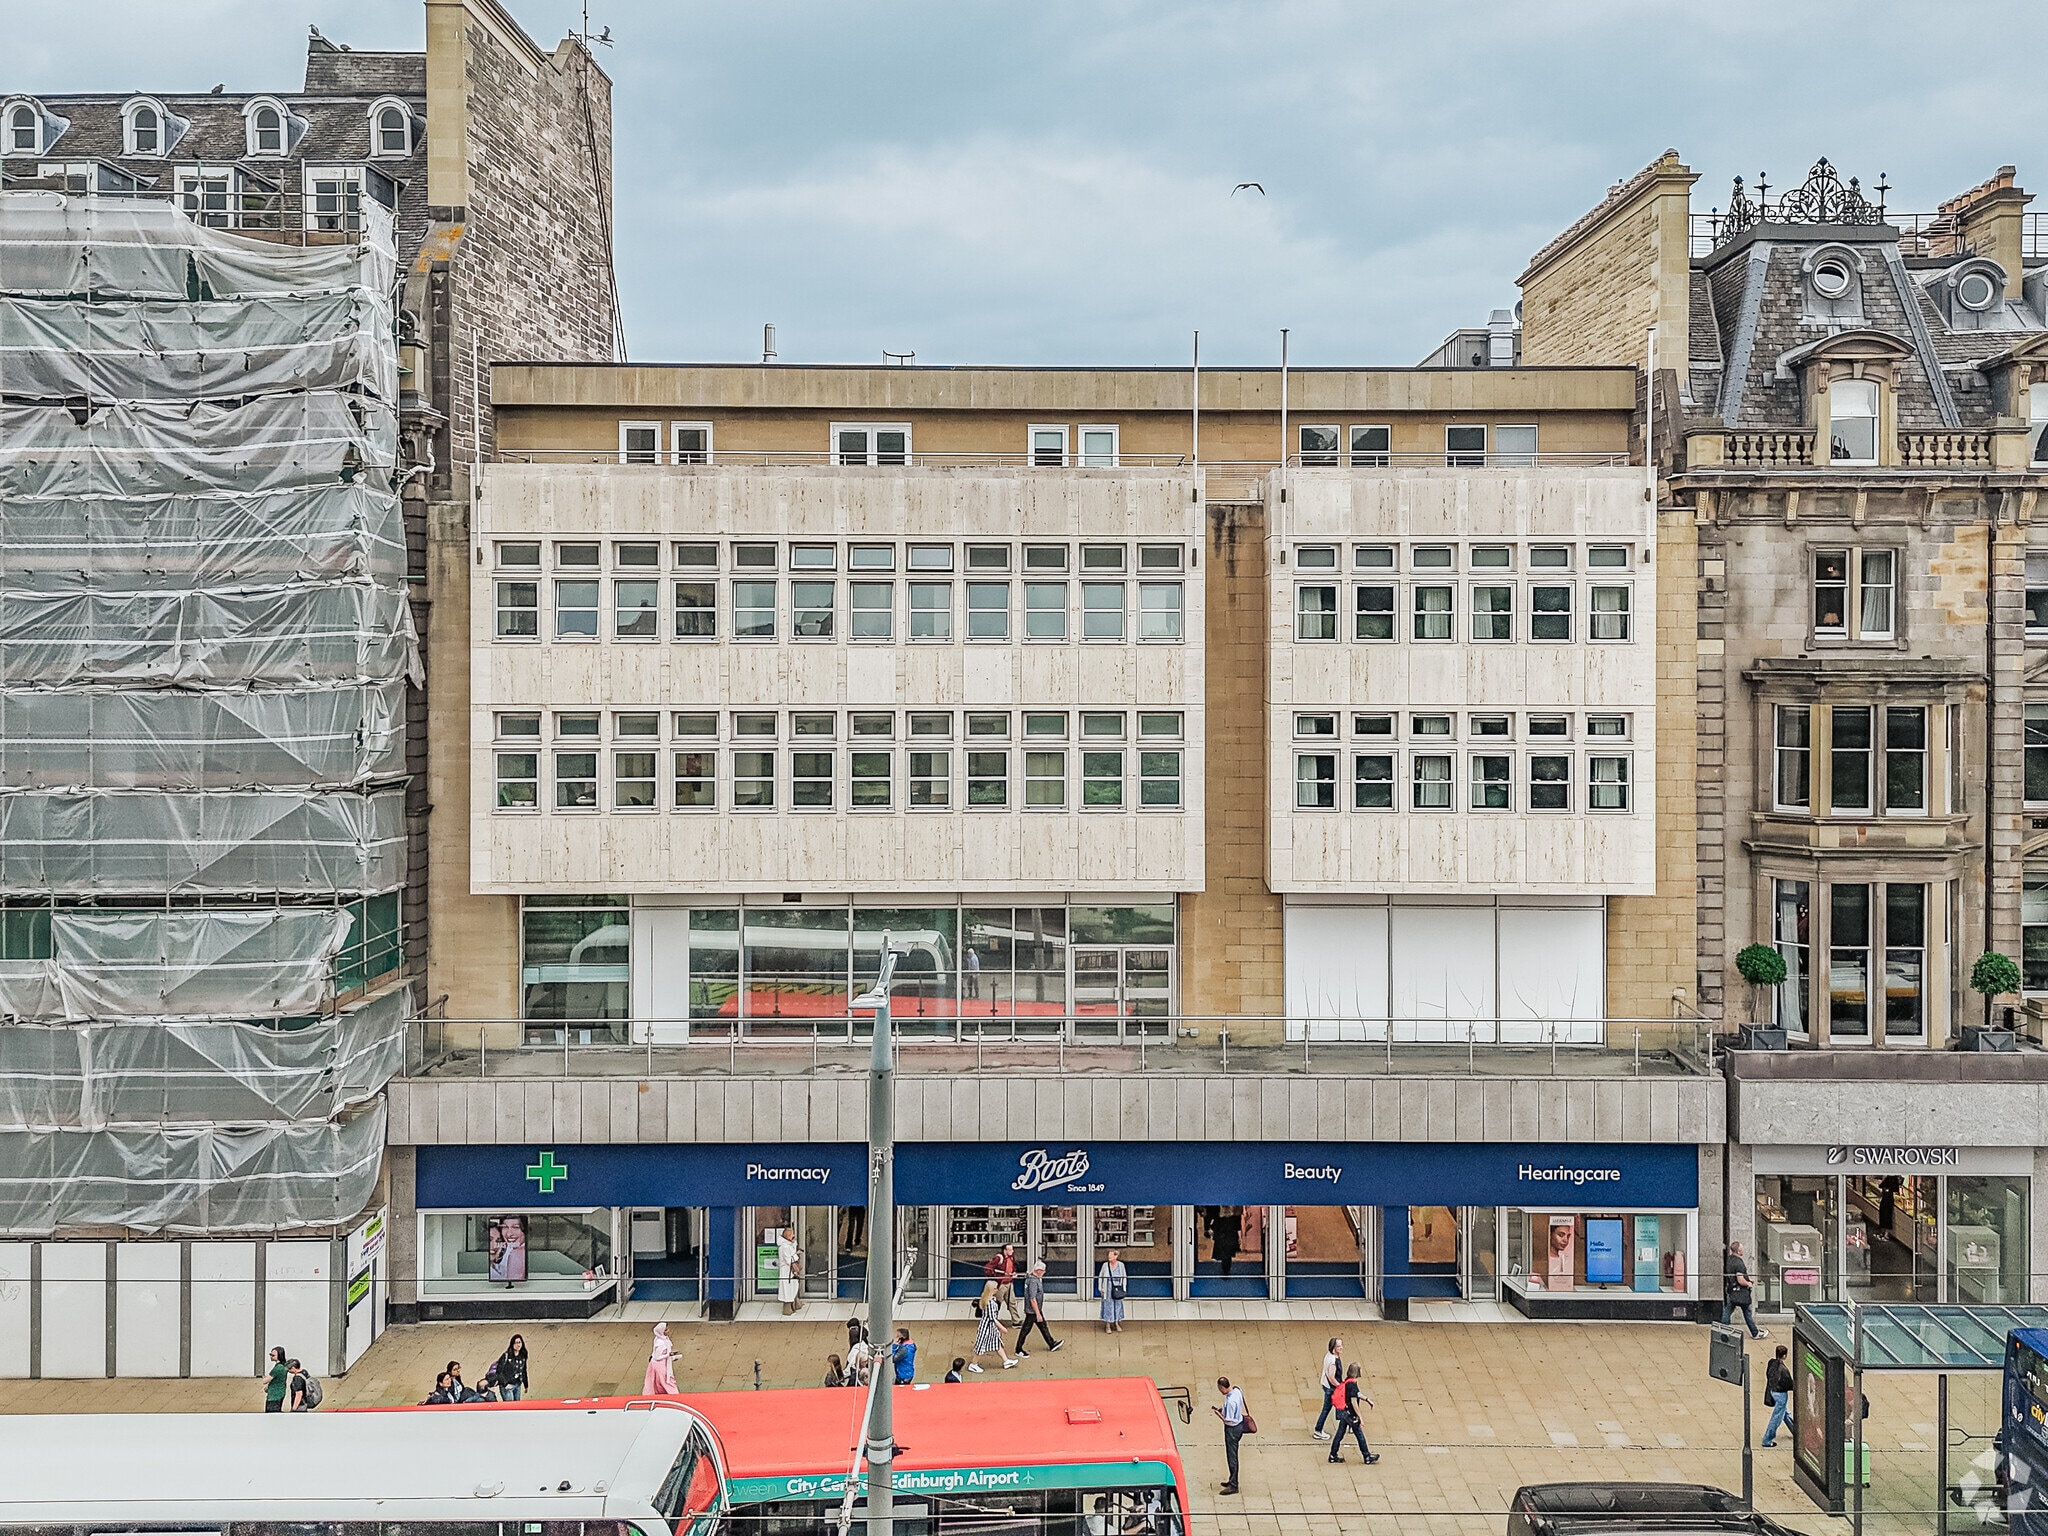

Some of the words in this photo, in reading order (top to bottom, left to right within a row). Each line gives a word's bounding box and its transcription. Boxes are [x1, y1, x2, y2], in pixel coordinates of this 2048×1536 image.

[1853, 1147, 1960, 1165] SWAROVSKI
[746, 1163, 831, 1184] Pharmacy
[1011, 1149, 1090, 1192] Boots
[1284, 1163, 1342, 1184] Beauty
[1518, 1164, 1621, 1186] Hearingcare
[1067, 1183, 1087, 1192] Since
[1088, 1183, 1105, 1192] 1849
[1791, 1273, 1812, 1281] SALE
[786, 1477, 817, 1497] City
[820, 1476, 869, 1493] Cenre
[892, 1471, 964, 1490] Edinburgh
[966, 1469, 1020, 1488] Airport
